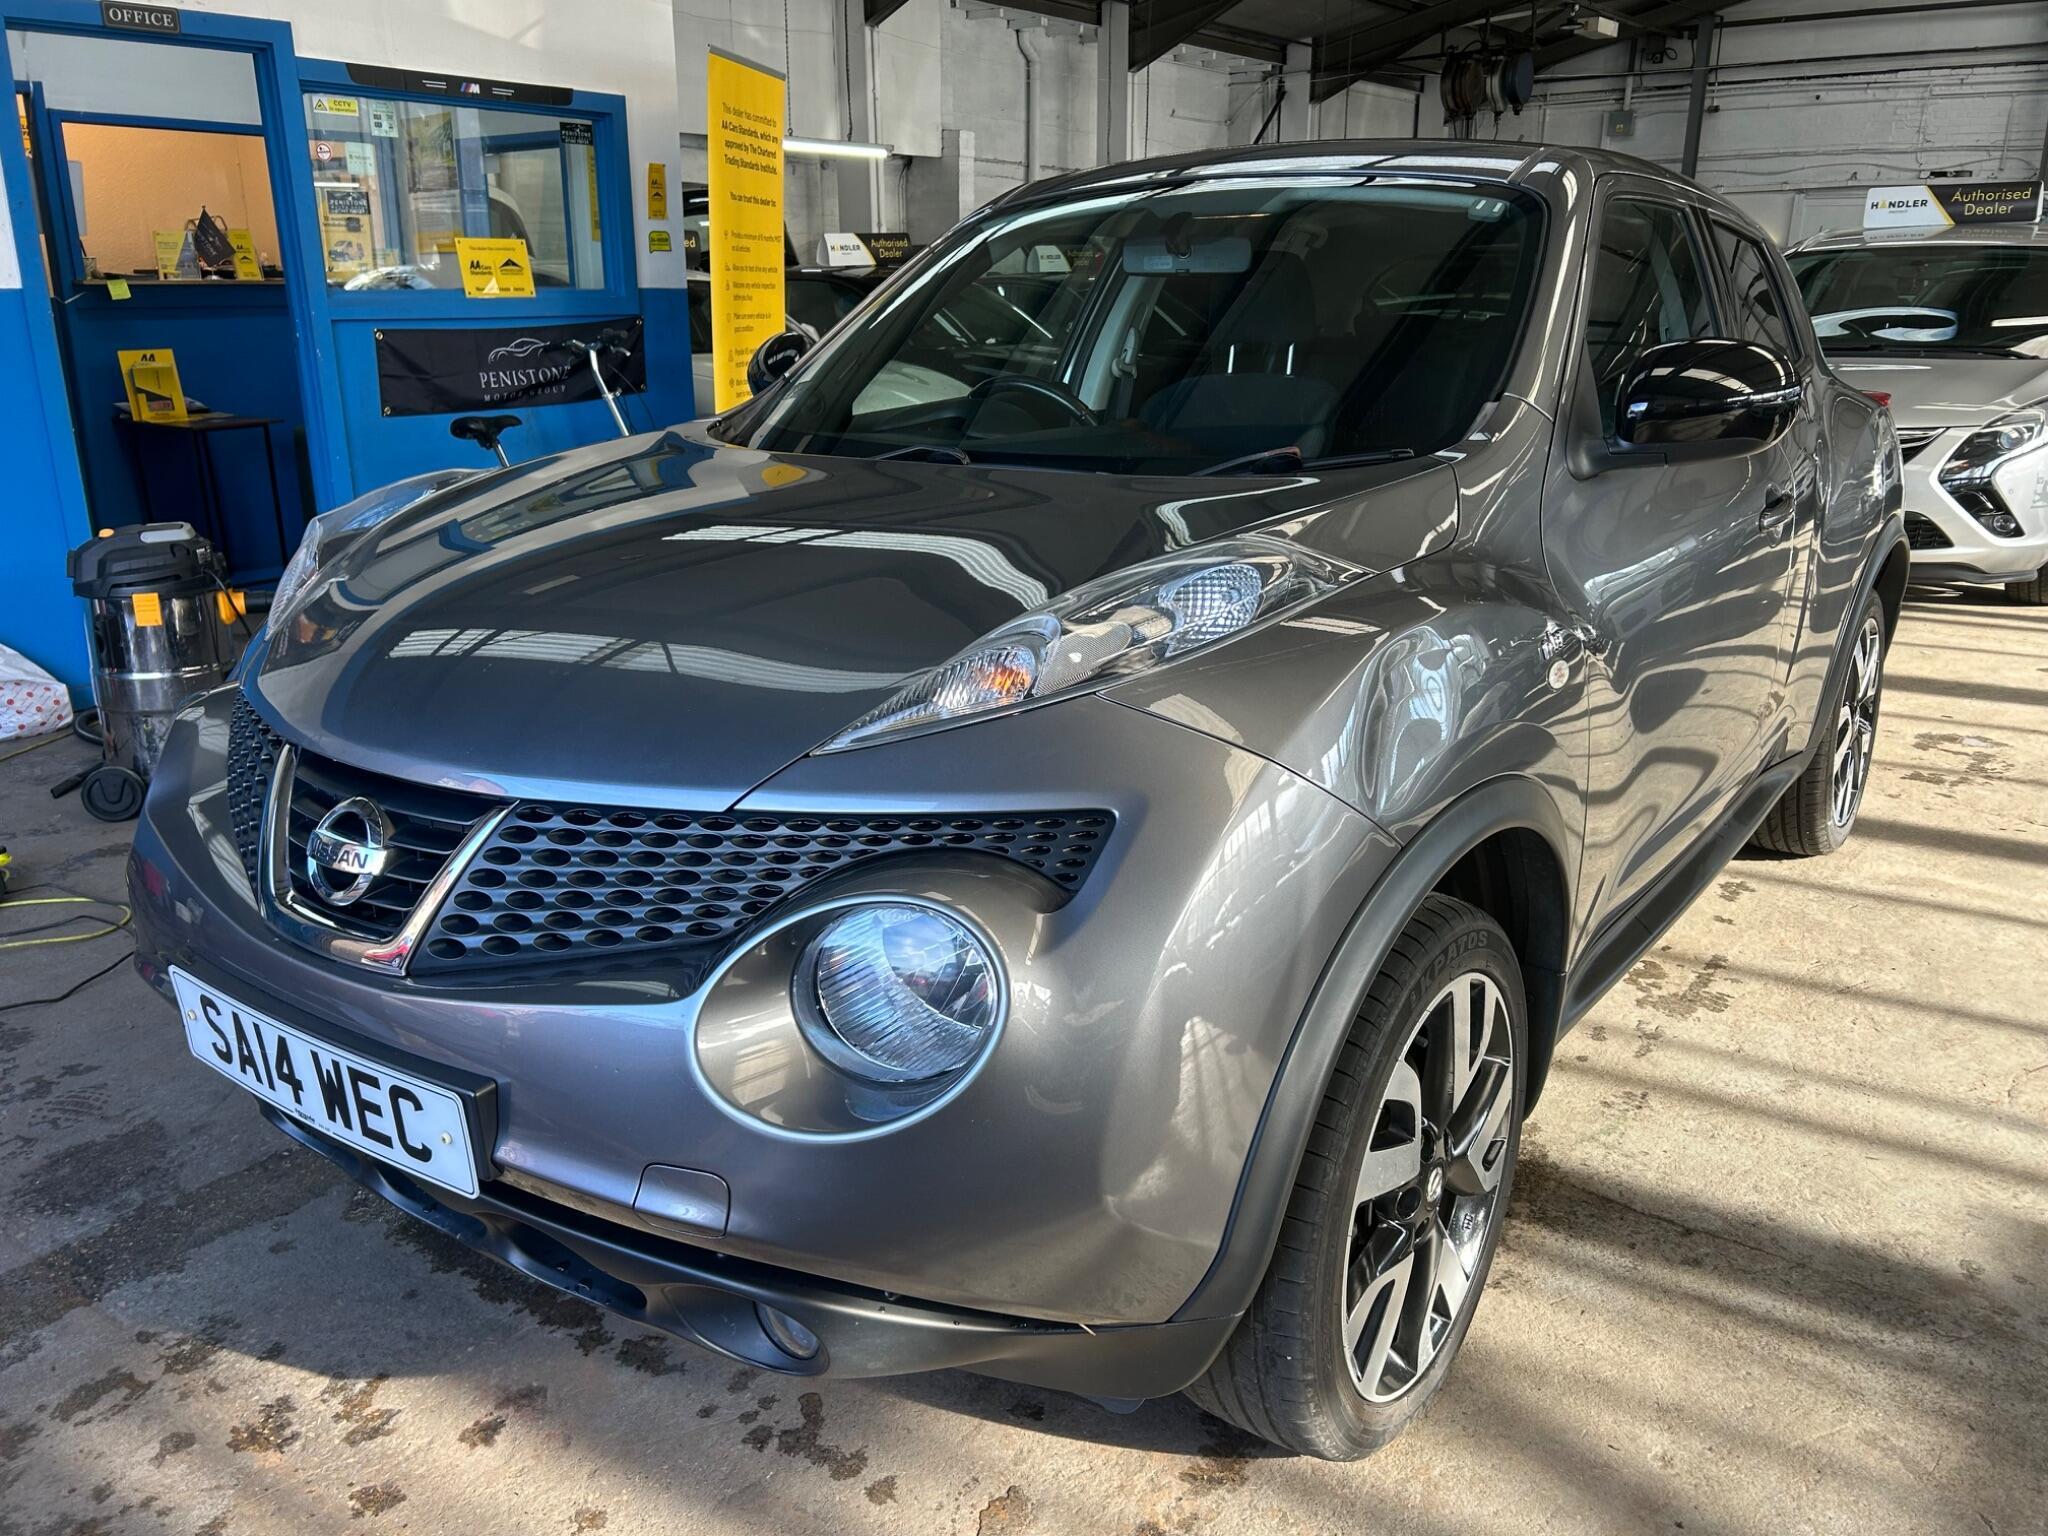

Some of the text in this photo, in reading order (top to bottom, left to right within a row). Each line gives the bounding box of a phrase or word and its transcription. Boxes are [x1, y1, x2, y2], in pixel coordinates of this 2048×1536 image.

[109, 8, 174, 27] OFFICE
[722, 119, 728, 130] AA
[749, 143, 757, 155] The
[724, 153, 740, 169] Trading
[1951, 187, 2032, 202] Authorised
[1870, 199, 1929, 210] HANDLER
[1964, 202, 2014, 216] Dealer
[871, 237, 908, 247] Authorised
[879, 248, 903, 258] Dealer
[469, 260, 481, 270] AA
[140, 353, 156, 362] AA
[479, 366, 570, 389] PENISTONE
[199, 993, 432, 1163] SA14 WEC
